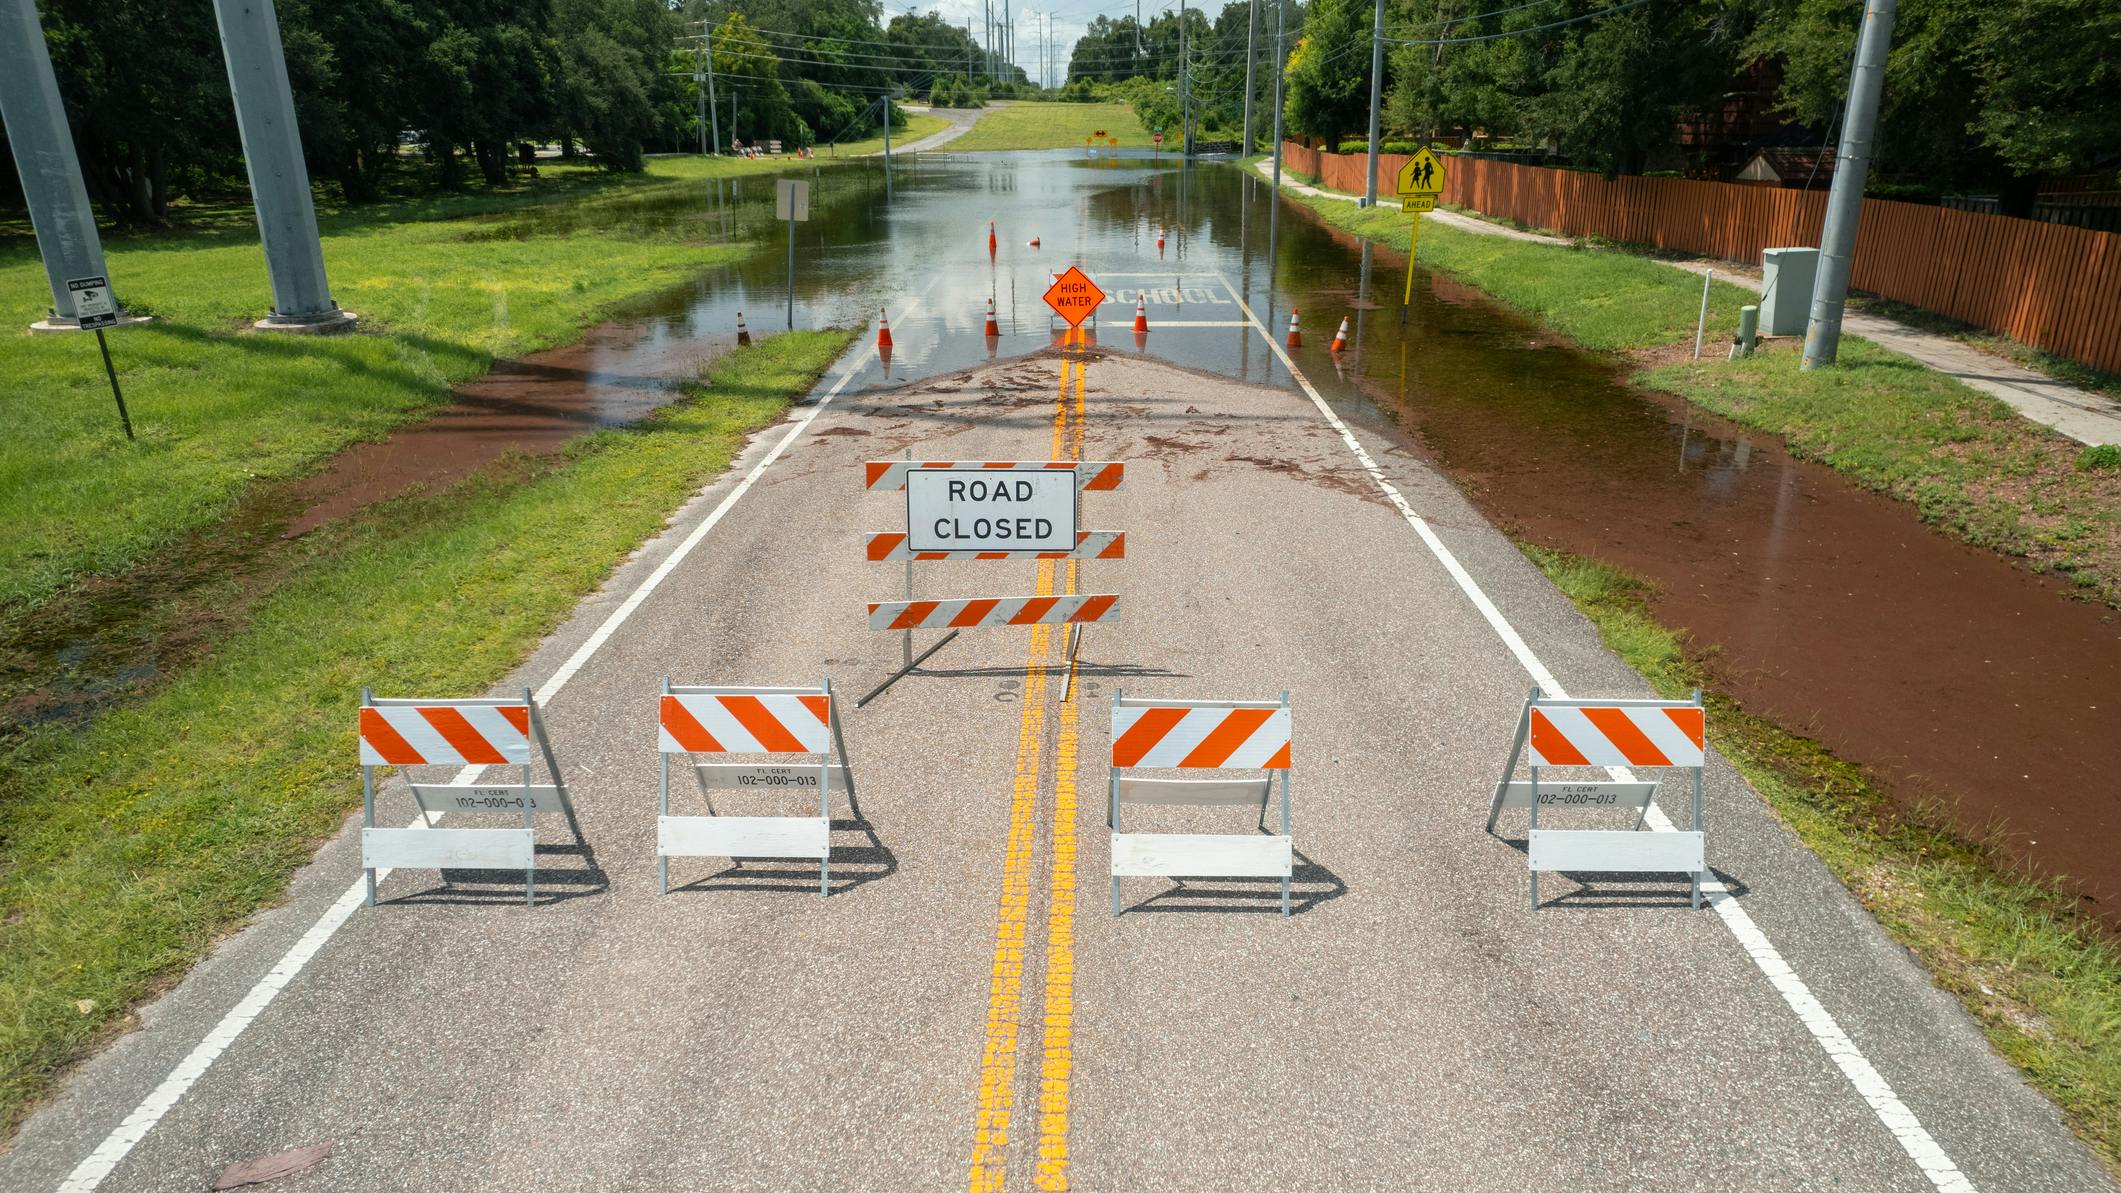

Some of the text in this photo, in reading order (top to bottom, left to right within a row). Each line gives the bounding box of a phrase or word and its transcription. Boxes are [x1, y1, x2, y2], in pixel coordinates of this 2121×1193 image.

[1406, 200, 1431, 209] AHEAD
[79, 279, 104, 288] DUMPING
[1060, 283, 1087, 293] HIGH
[1057, 296, 1092, 307] WATER
[82, 319, 116, 328] TRESPASSING
[948, 480, 1034, 502] ROAD
[934, 518, 1053, 539] CLOSED
[737, 775, 817, 786] 102-000-013
[456, 797, 537, 809] 102-000-03
[1536, 794, 1617, 805] 102-000-013
